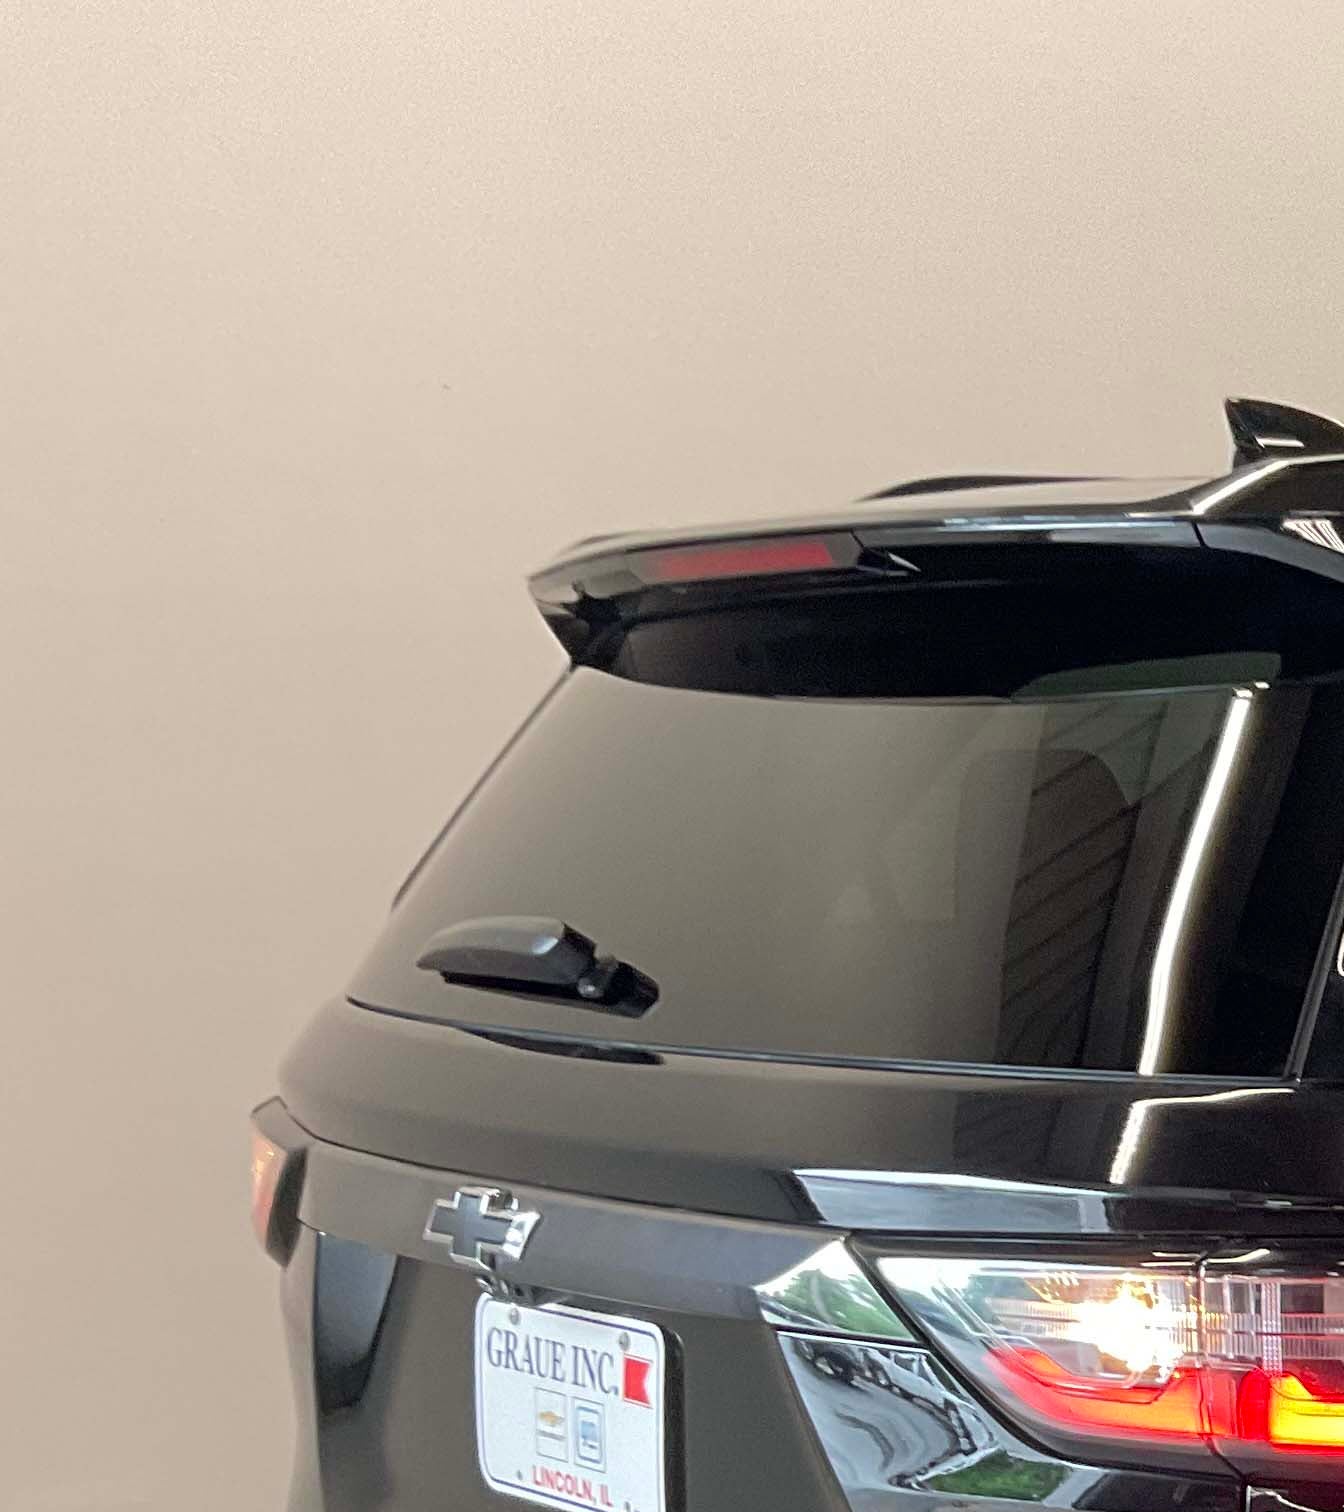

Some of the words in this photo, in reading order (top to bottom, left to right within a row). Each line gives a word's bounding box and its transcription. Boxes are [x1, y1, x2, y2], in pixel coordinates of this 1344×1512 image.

[487, 1327, 566, 1383] GRAUE
[570, 1344, 619, 1397] INC.
[532, 1465, 598, 1507] LINCOLN,
[600, 1483, 614, 1508] IL
